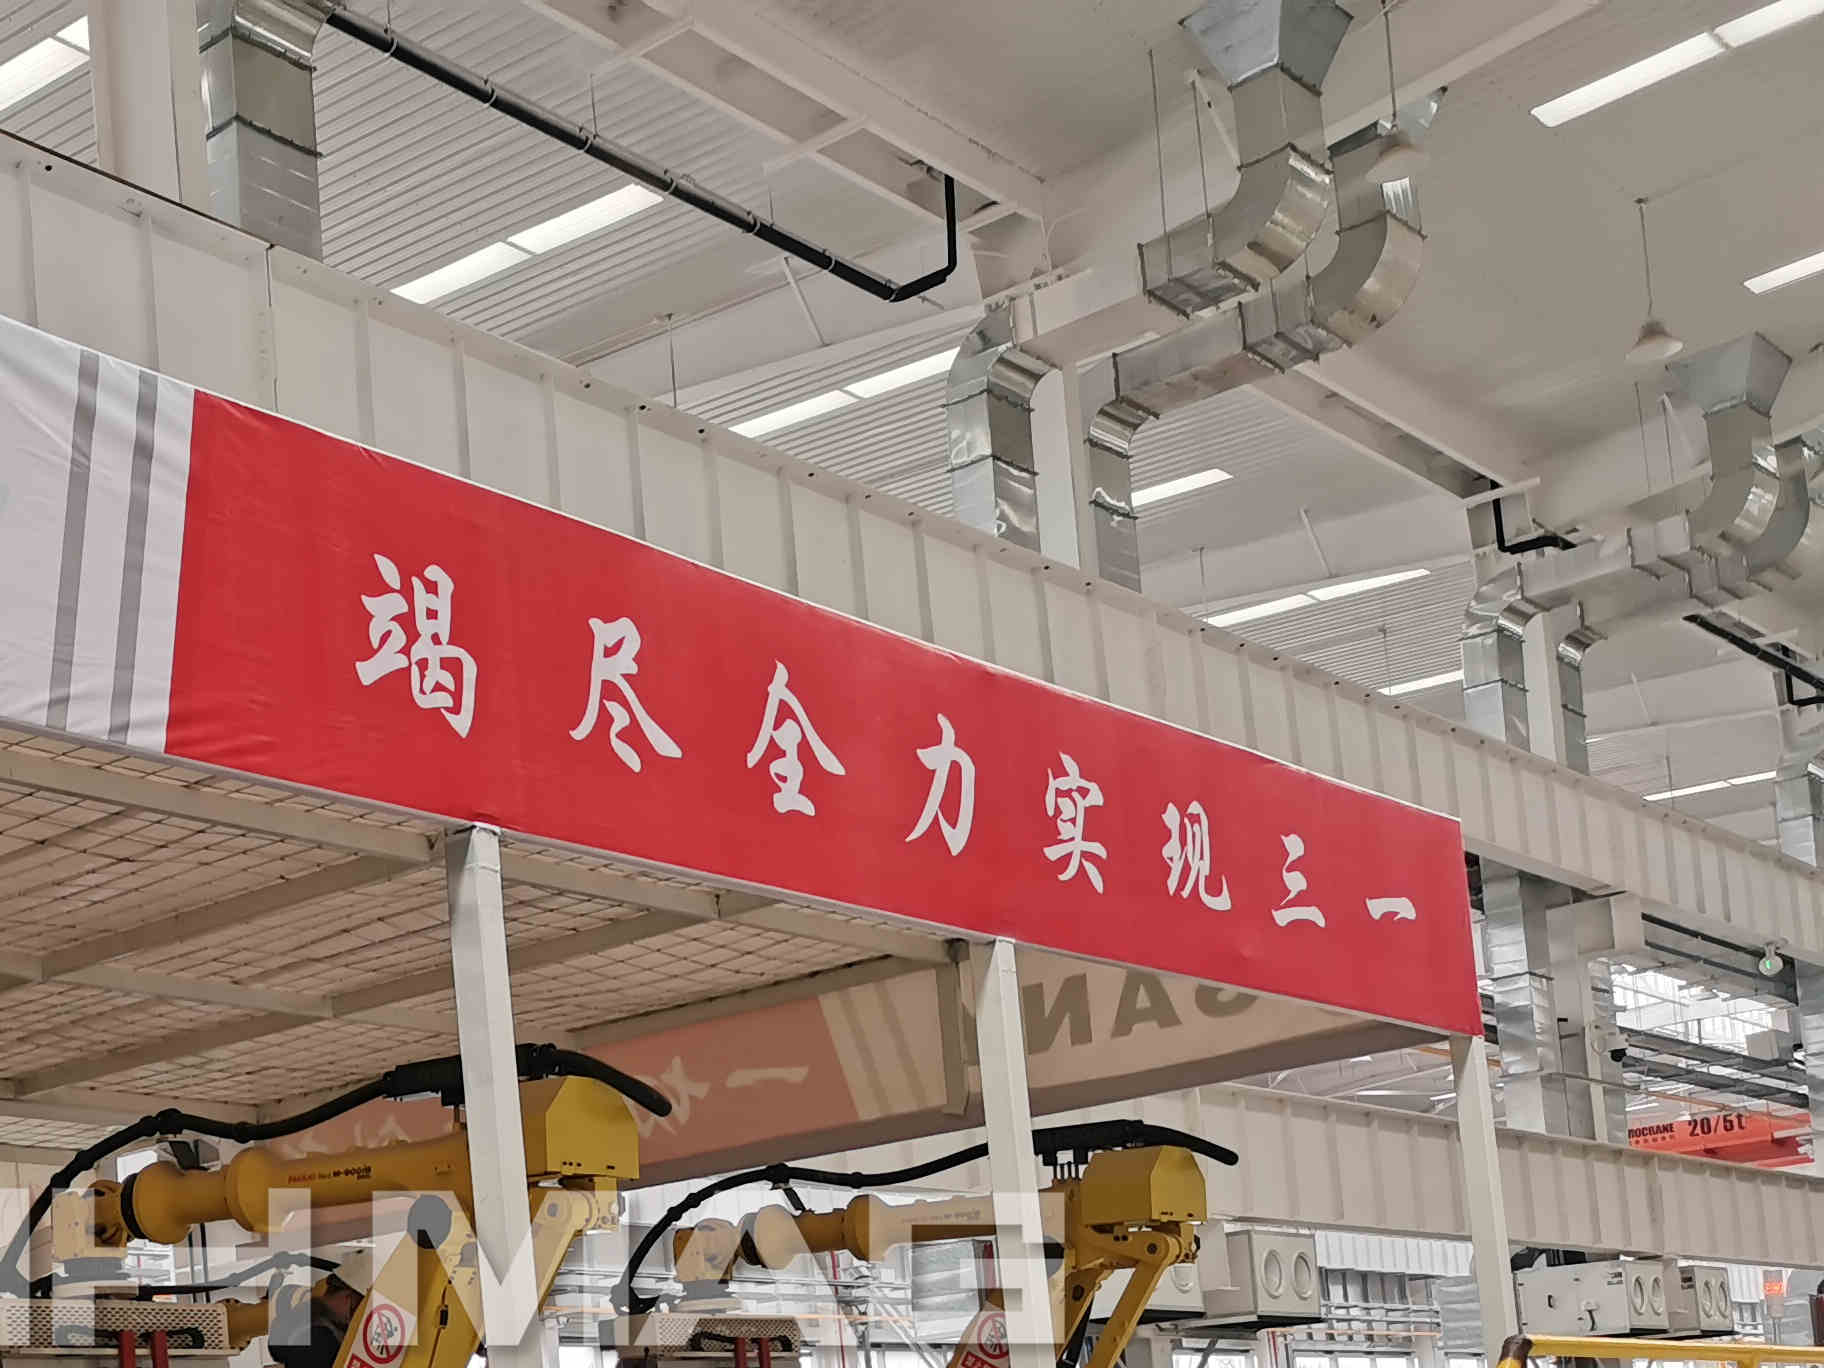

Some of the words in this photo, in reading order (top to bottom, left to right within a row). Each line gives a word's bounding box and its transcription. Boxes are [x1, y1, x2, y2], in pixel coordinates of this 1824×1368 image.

[354, 554, 1417, 926] 竭尽全力实现三一
